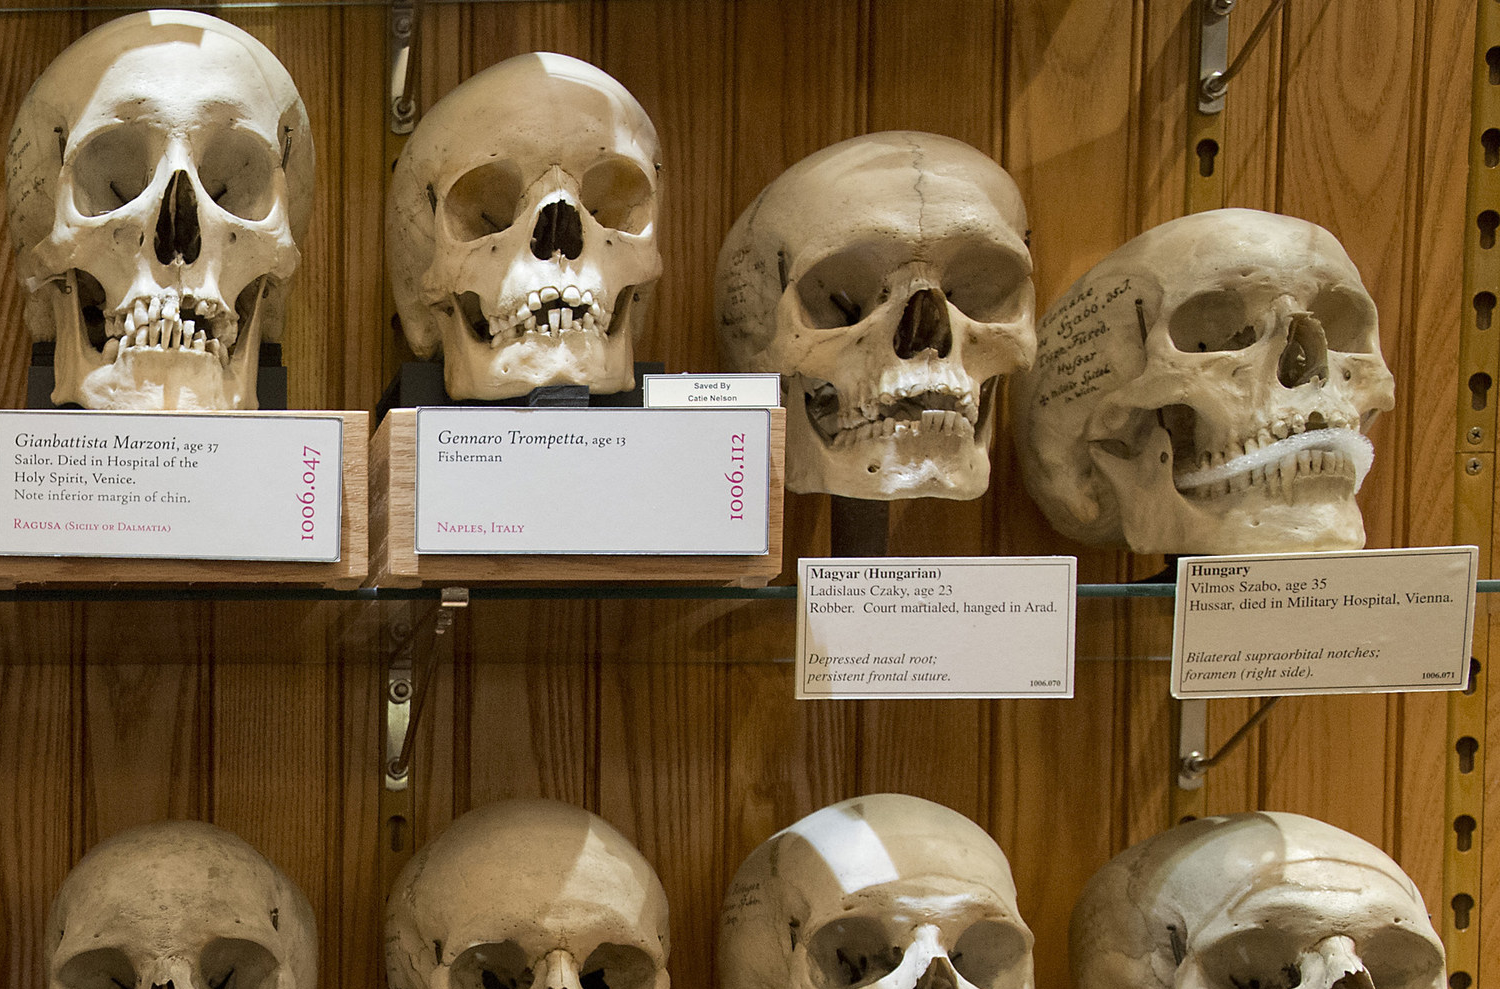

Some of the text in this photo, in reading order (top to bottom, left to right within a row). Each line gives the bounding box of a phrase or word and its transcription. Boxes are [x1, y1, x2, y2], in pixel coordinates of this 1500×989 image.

[693, 381, 731, 391] Saved By
[687, 394, 737, 402] Catie Nelson
[14, 432, 219, 454] Gianbattista Marzoni, age 37
[437, 429, 626, 449] Gennaro Trompetta, age 13
[14, 453, 198, 469] Sailor. Died in Hospital of the
[437, 450, 502, 462] Fisherman
[296, 445, 322, 541] 1006.047
[810, 567, 942, 582] Magyar (Hungarian)
[1191, 564, 1251, 578] Hungary
[810, 584, 953, 598] Ladislaus Czaky, age 23
[1190, 577, 1327, 594] Vilmos Szabo, age 35
[807, 653, 937, 667] Depressed nasal root;
[1182, 665, 1313, 683] foramen (right side).
